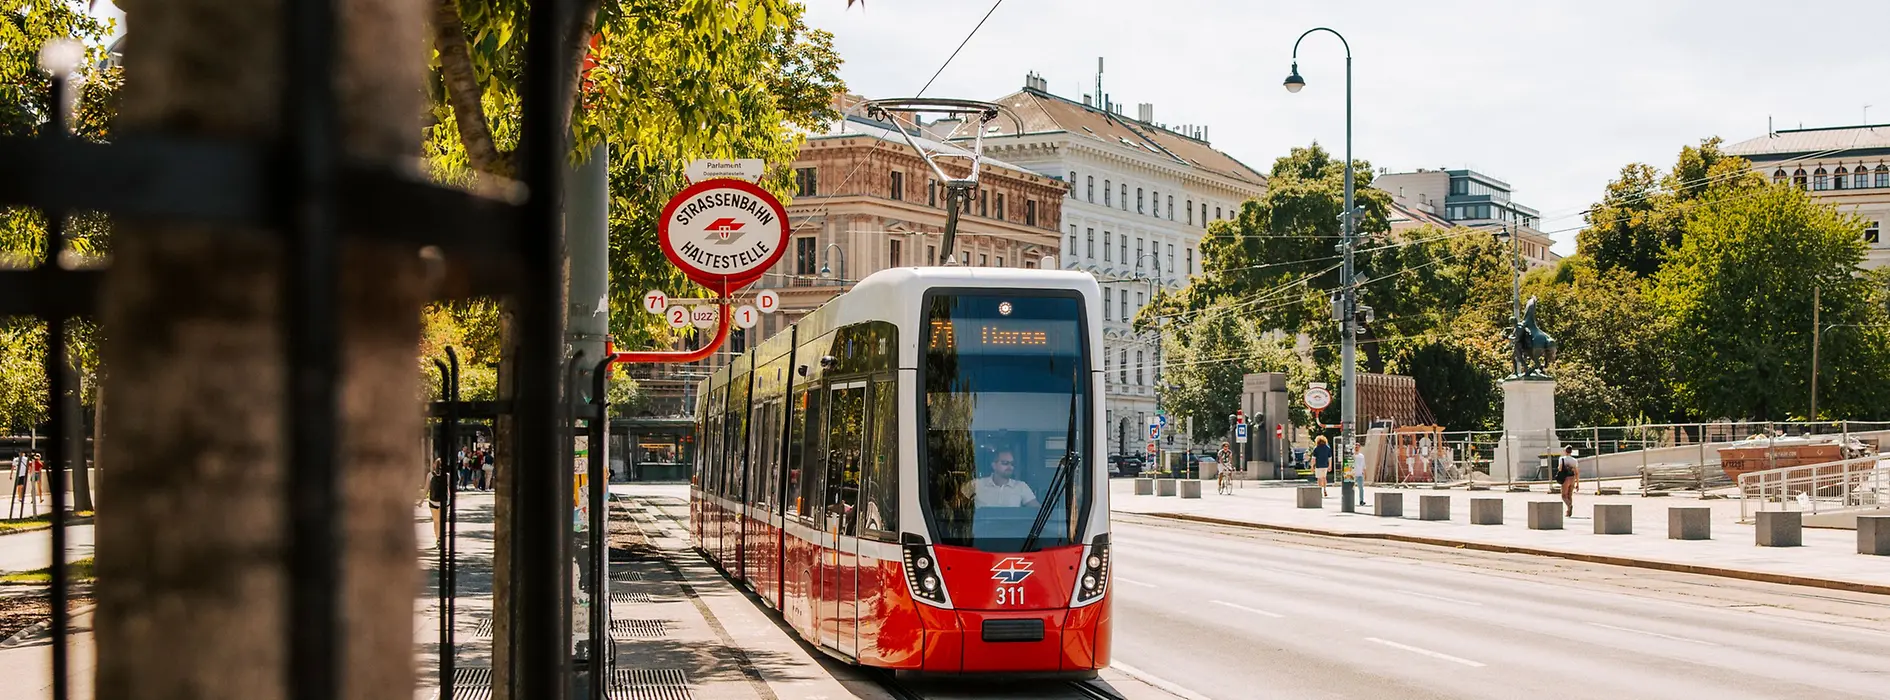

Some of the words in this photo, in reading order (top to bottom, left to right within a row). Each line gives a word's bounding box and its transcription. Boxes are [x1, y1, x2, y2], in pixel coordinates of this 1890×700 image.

[676, 193, 774, 226] STRASSENBAHN
[680, 240, 770, 269] HALTESTELLE
[648, 295, 665, 309] 71
[762, 295, 773, 308] D
[673, 310, 683, 324] 2
[693, 312, 713, 321] U2Z
[743, 310, 750, 323] 1
[931, 322, 952, 348] 71
[996, 586, 1024, 605] 311
